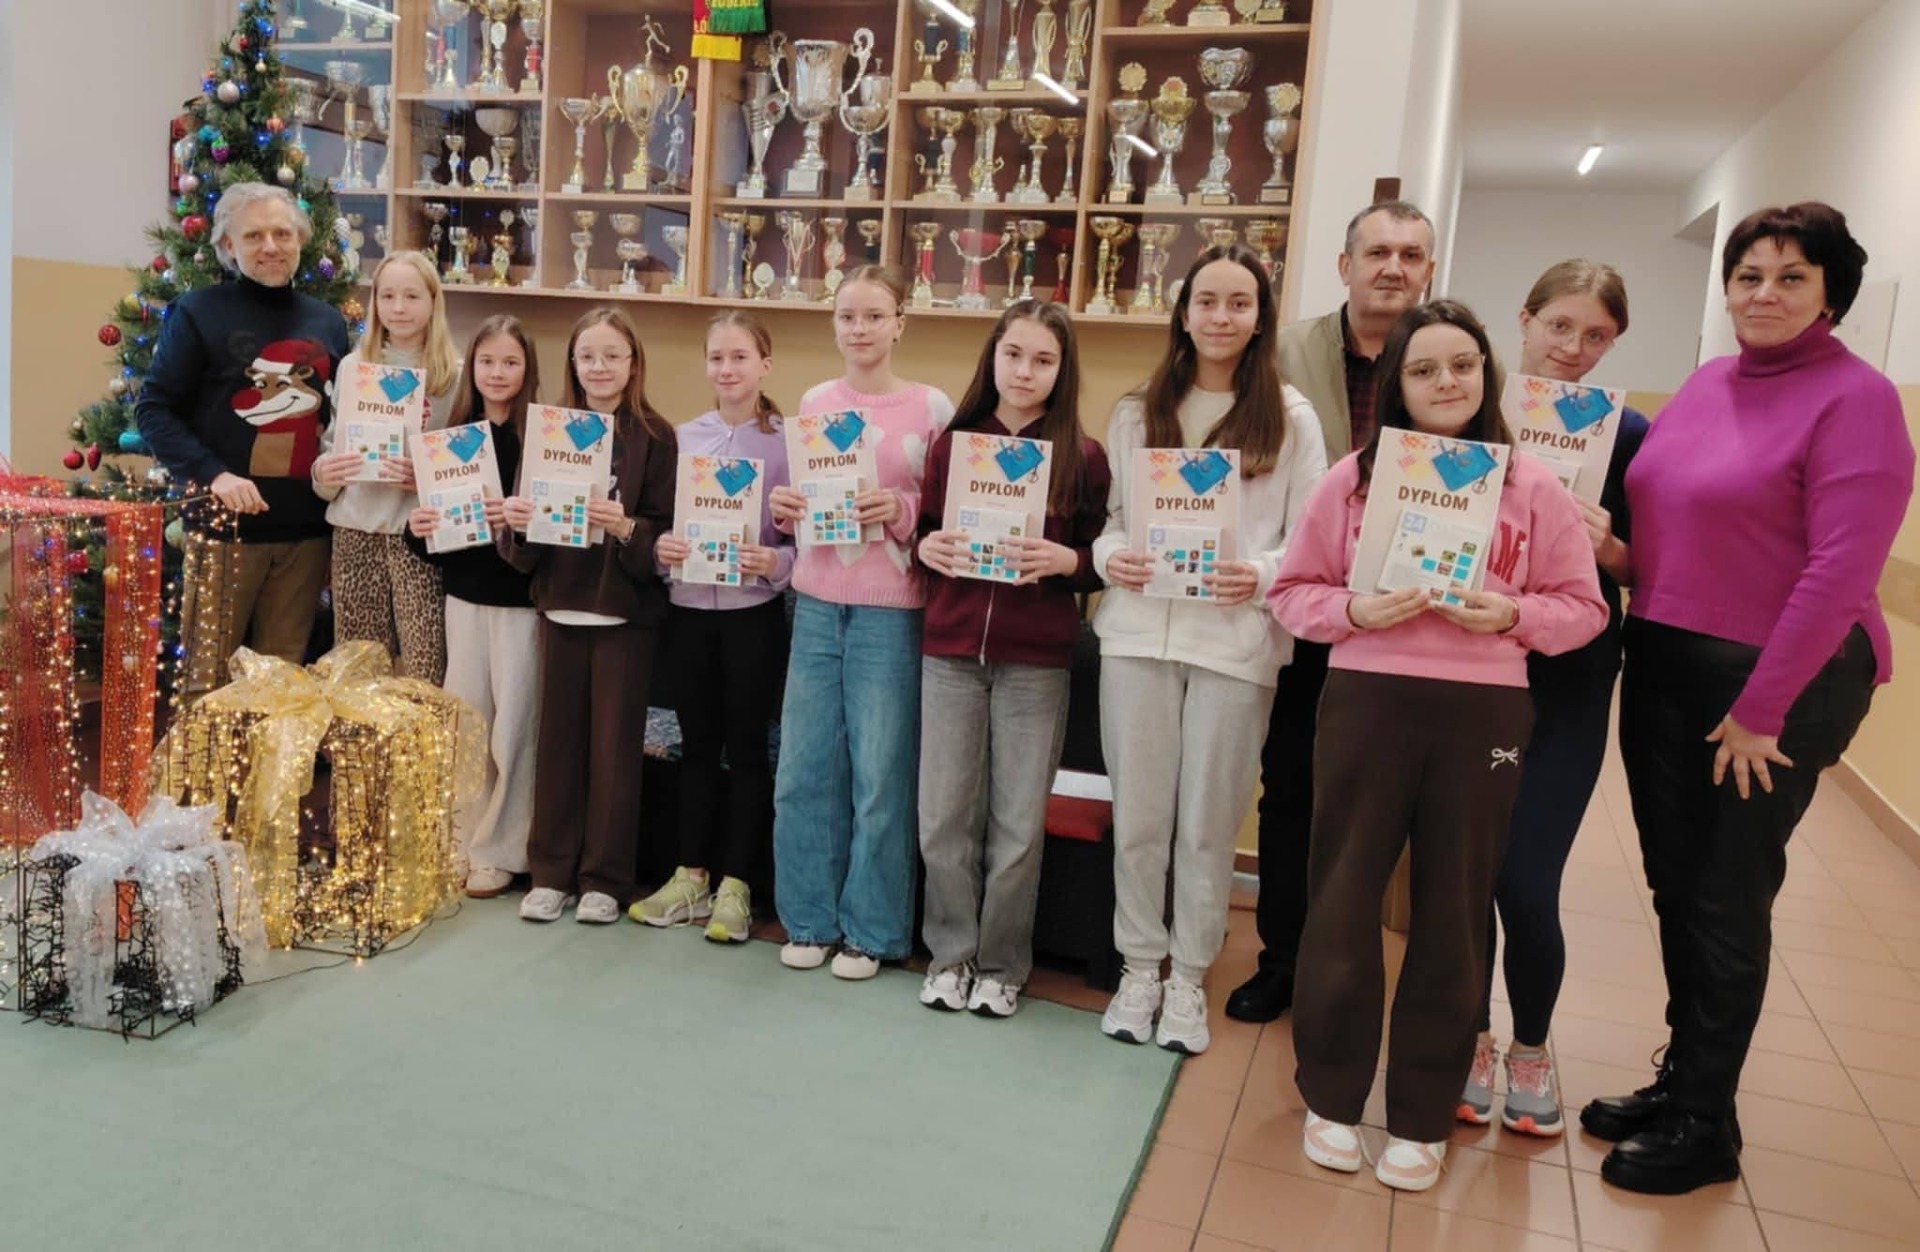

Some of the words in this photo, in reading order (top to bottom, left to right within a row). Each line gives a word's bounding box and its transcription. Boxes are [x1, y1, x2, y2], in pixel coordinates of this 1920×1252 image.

[358, 401, 405, 416] DYPLOM
[1519, 427, 1587, 453] DYPLOM
[543, 449, 593, 466] DYPLOM
[808, 453, 857, 470] DYPLOM
[435, 463, 480, 481] DYPLOM
[969, 480, 1026, 498] DYPLOM
[694, 496, 743, 511] DYPLOM
[1155, 497, 1215, 511] DYPLOM
[1397, 485, 1469, 511] DYPLOM
